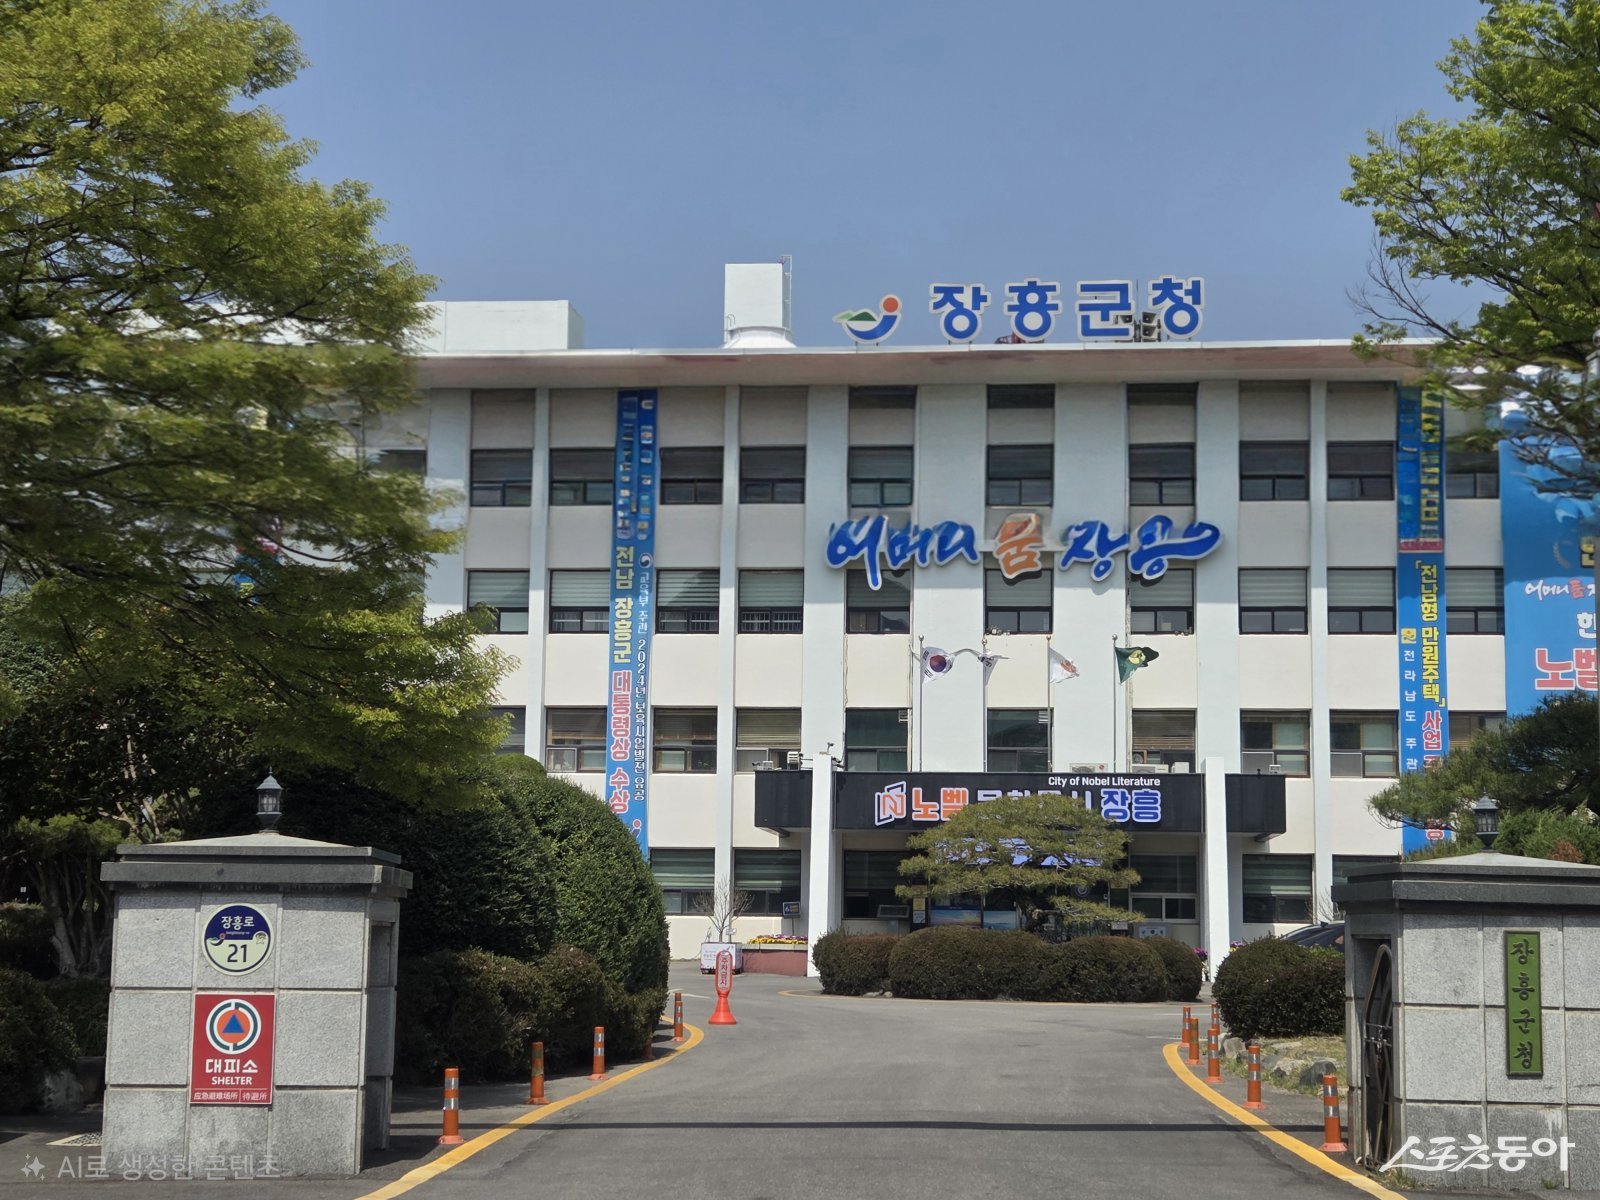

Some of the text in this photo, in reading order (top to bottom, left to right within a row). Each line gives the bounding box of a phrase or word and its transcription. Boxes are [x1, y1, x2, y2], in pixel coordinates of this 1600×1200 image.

[929, 275, 1204, 343] 장흥군청
[613, 596, 635, 664] 장흥군
[611, 670, 632, 762] 대통령상
[1404, 650, 1418, 770] 전라남도 주관
[1422, 710, 1442, 750] 사업
[608, 767, 630, 814] 수상
[1048, 776, 1160, 787] City of Nobel Literature
[1100, 788, 1162, 823] 장흥
[221, 915, 255, 930] 장흥로
[227, 943, 248, 963] 21
[1509, 938, 1535, 1069] 장흥군청
[205, 1058, 259, 1074] 대피소
[211, 1076, 253, 1085] SHELTER
